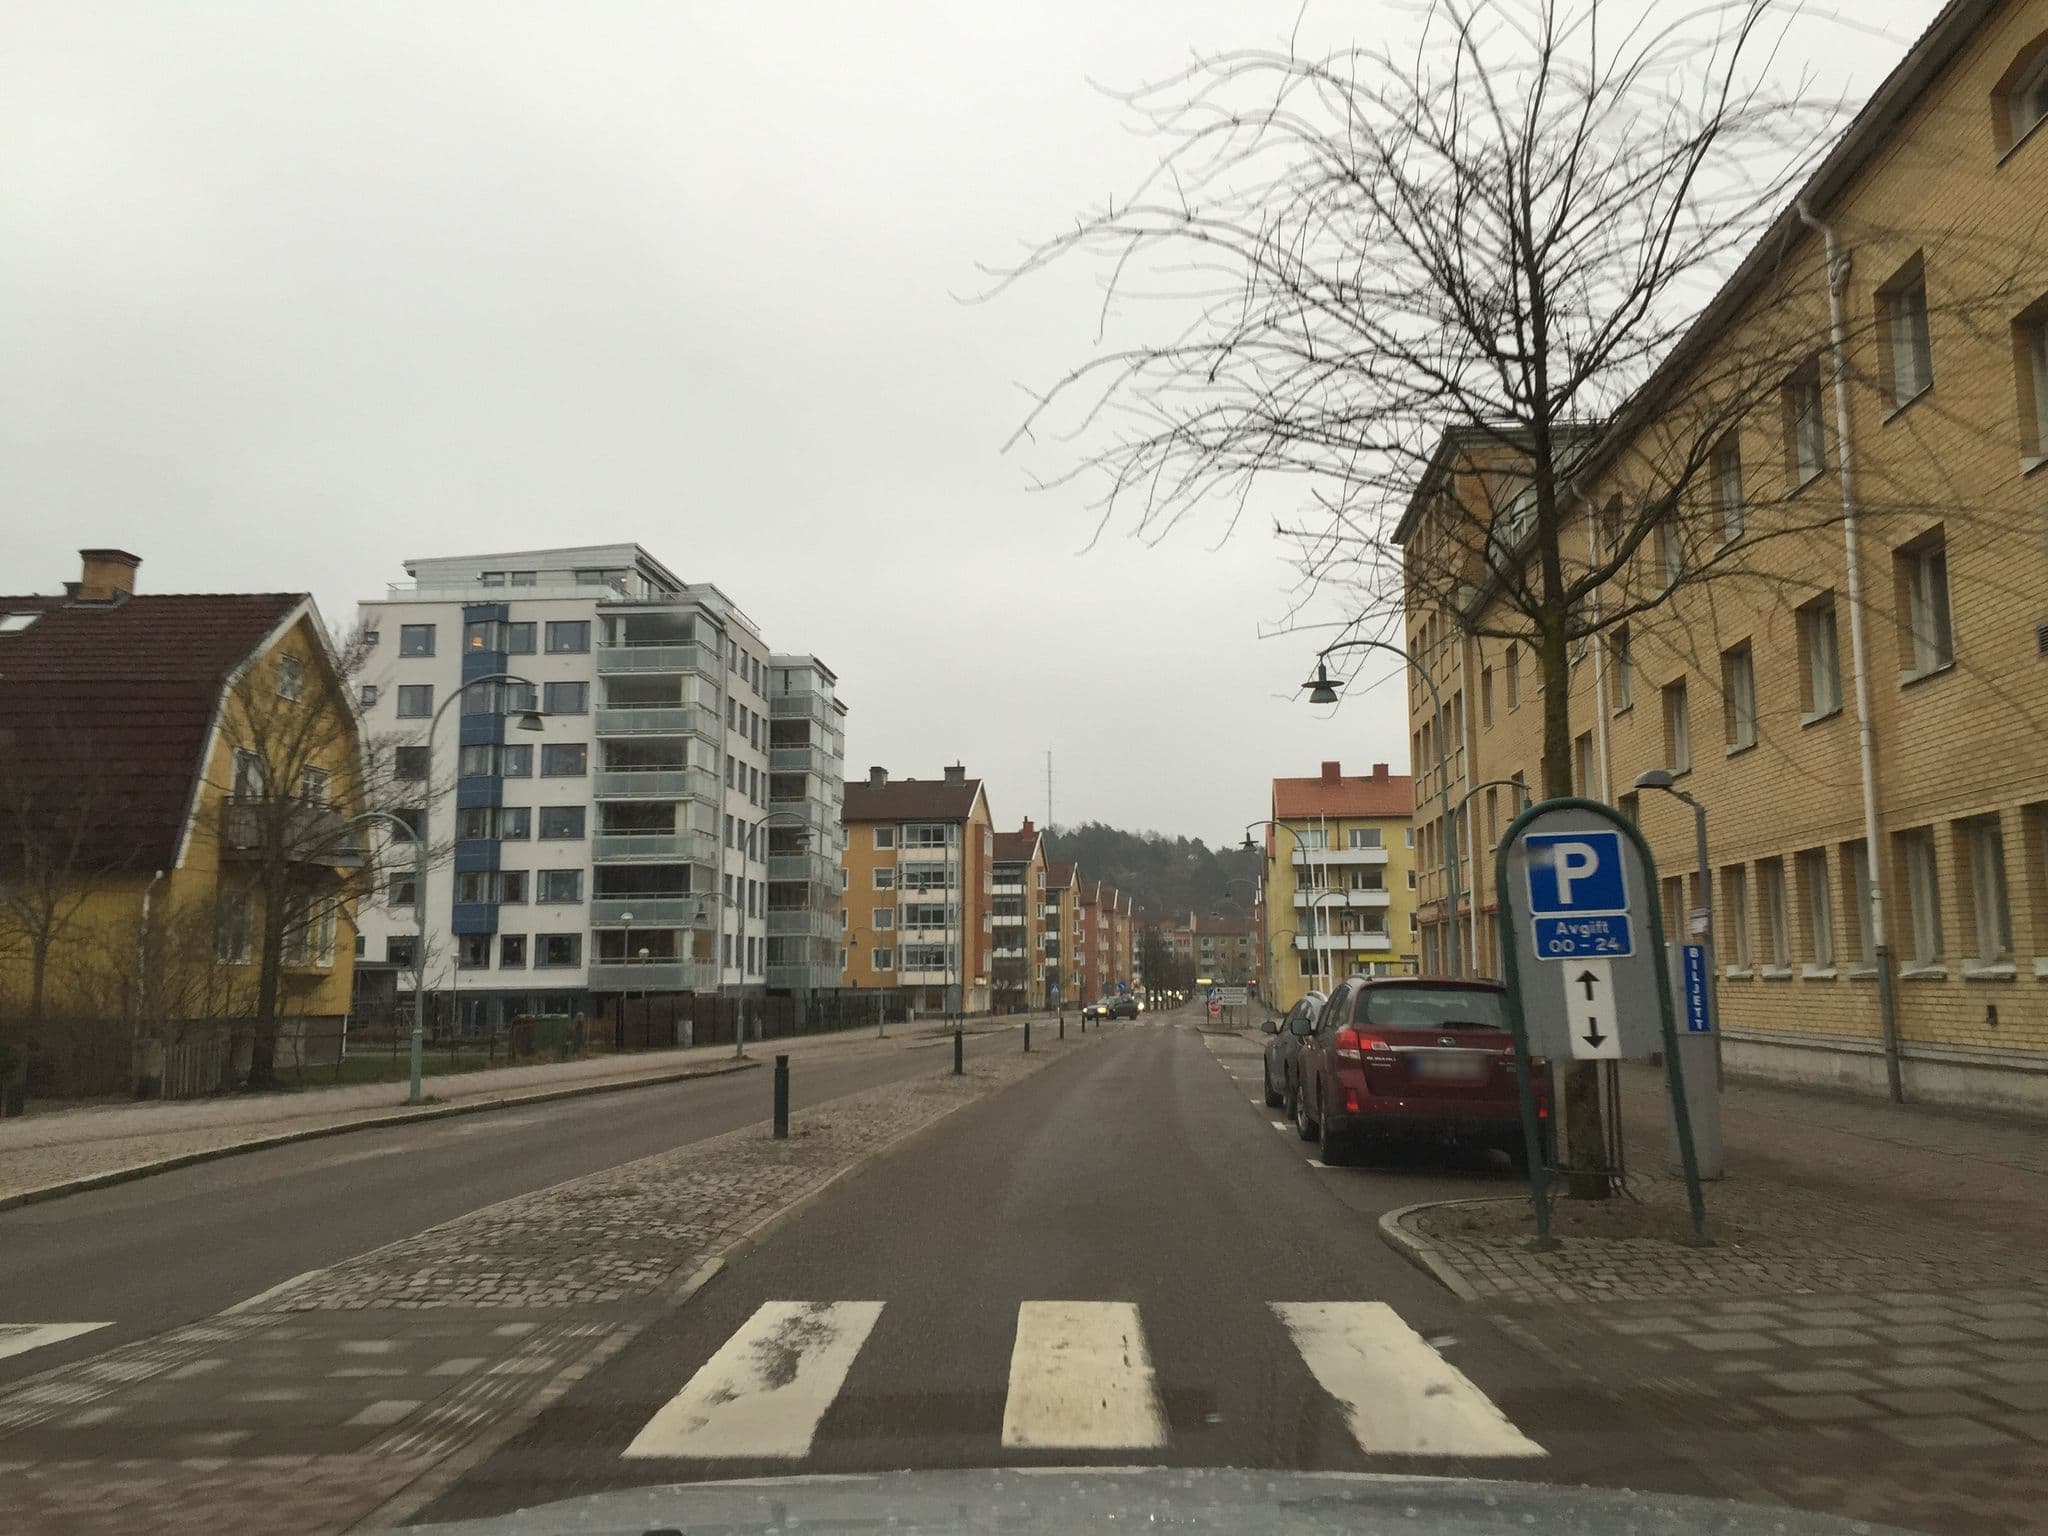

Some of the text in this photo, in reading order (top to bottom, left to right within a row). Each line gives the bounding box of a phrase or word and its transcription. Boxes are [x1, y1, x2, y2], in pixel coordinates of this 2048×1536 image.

[1553, 842, 1600, 904] P
[1548, 938, 1576, 953] 00
[1594, 936, 1621, 951] 24
[1555, 920, 1609, 938] Avgift
[1689, 947, 1703, 1030] BILJETT
